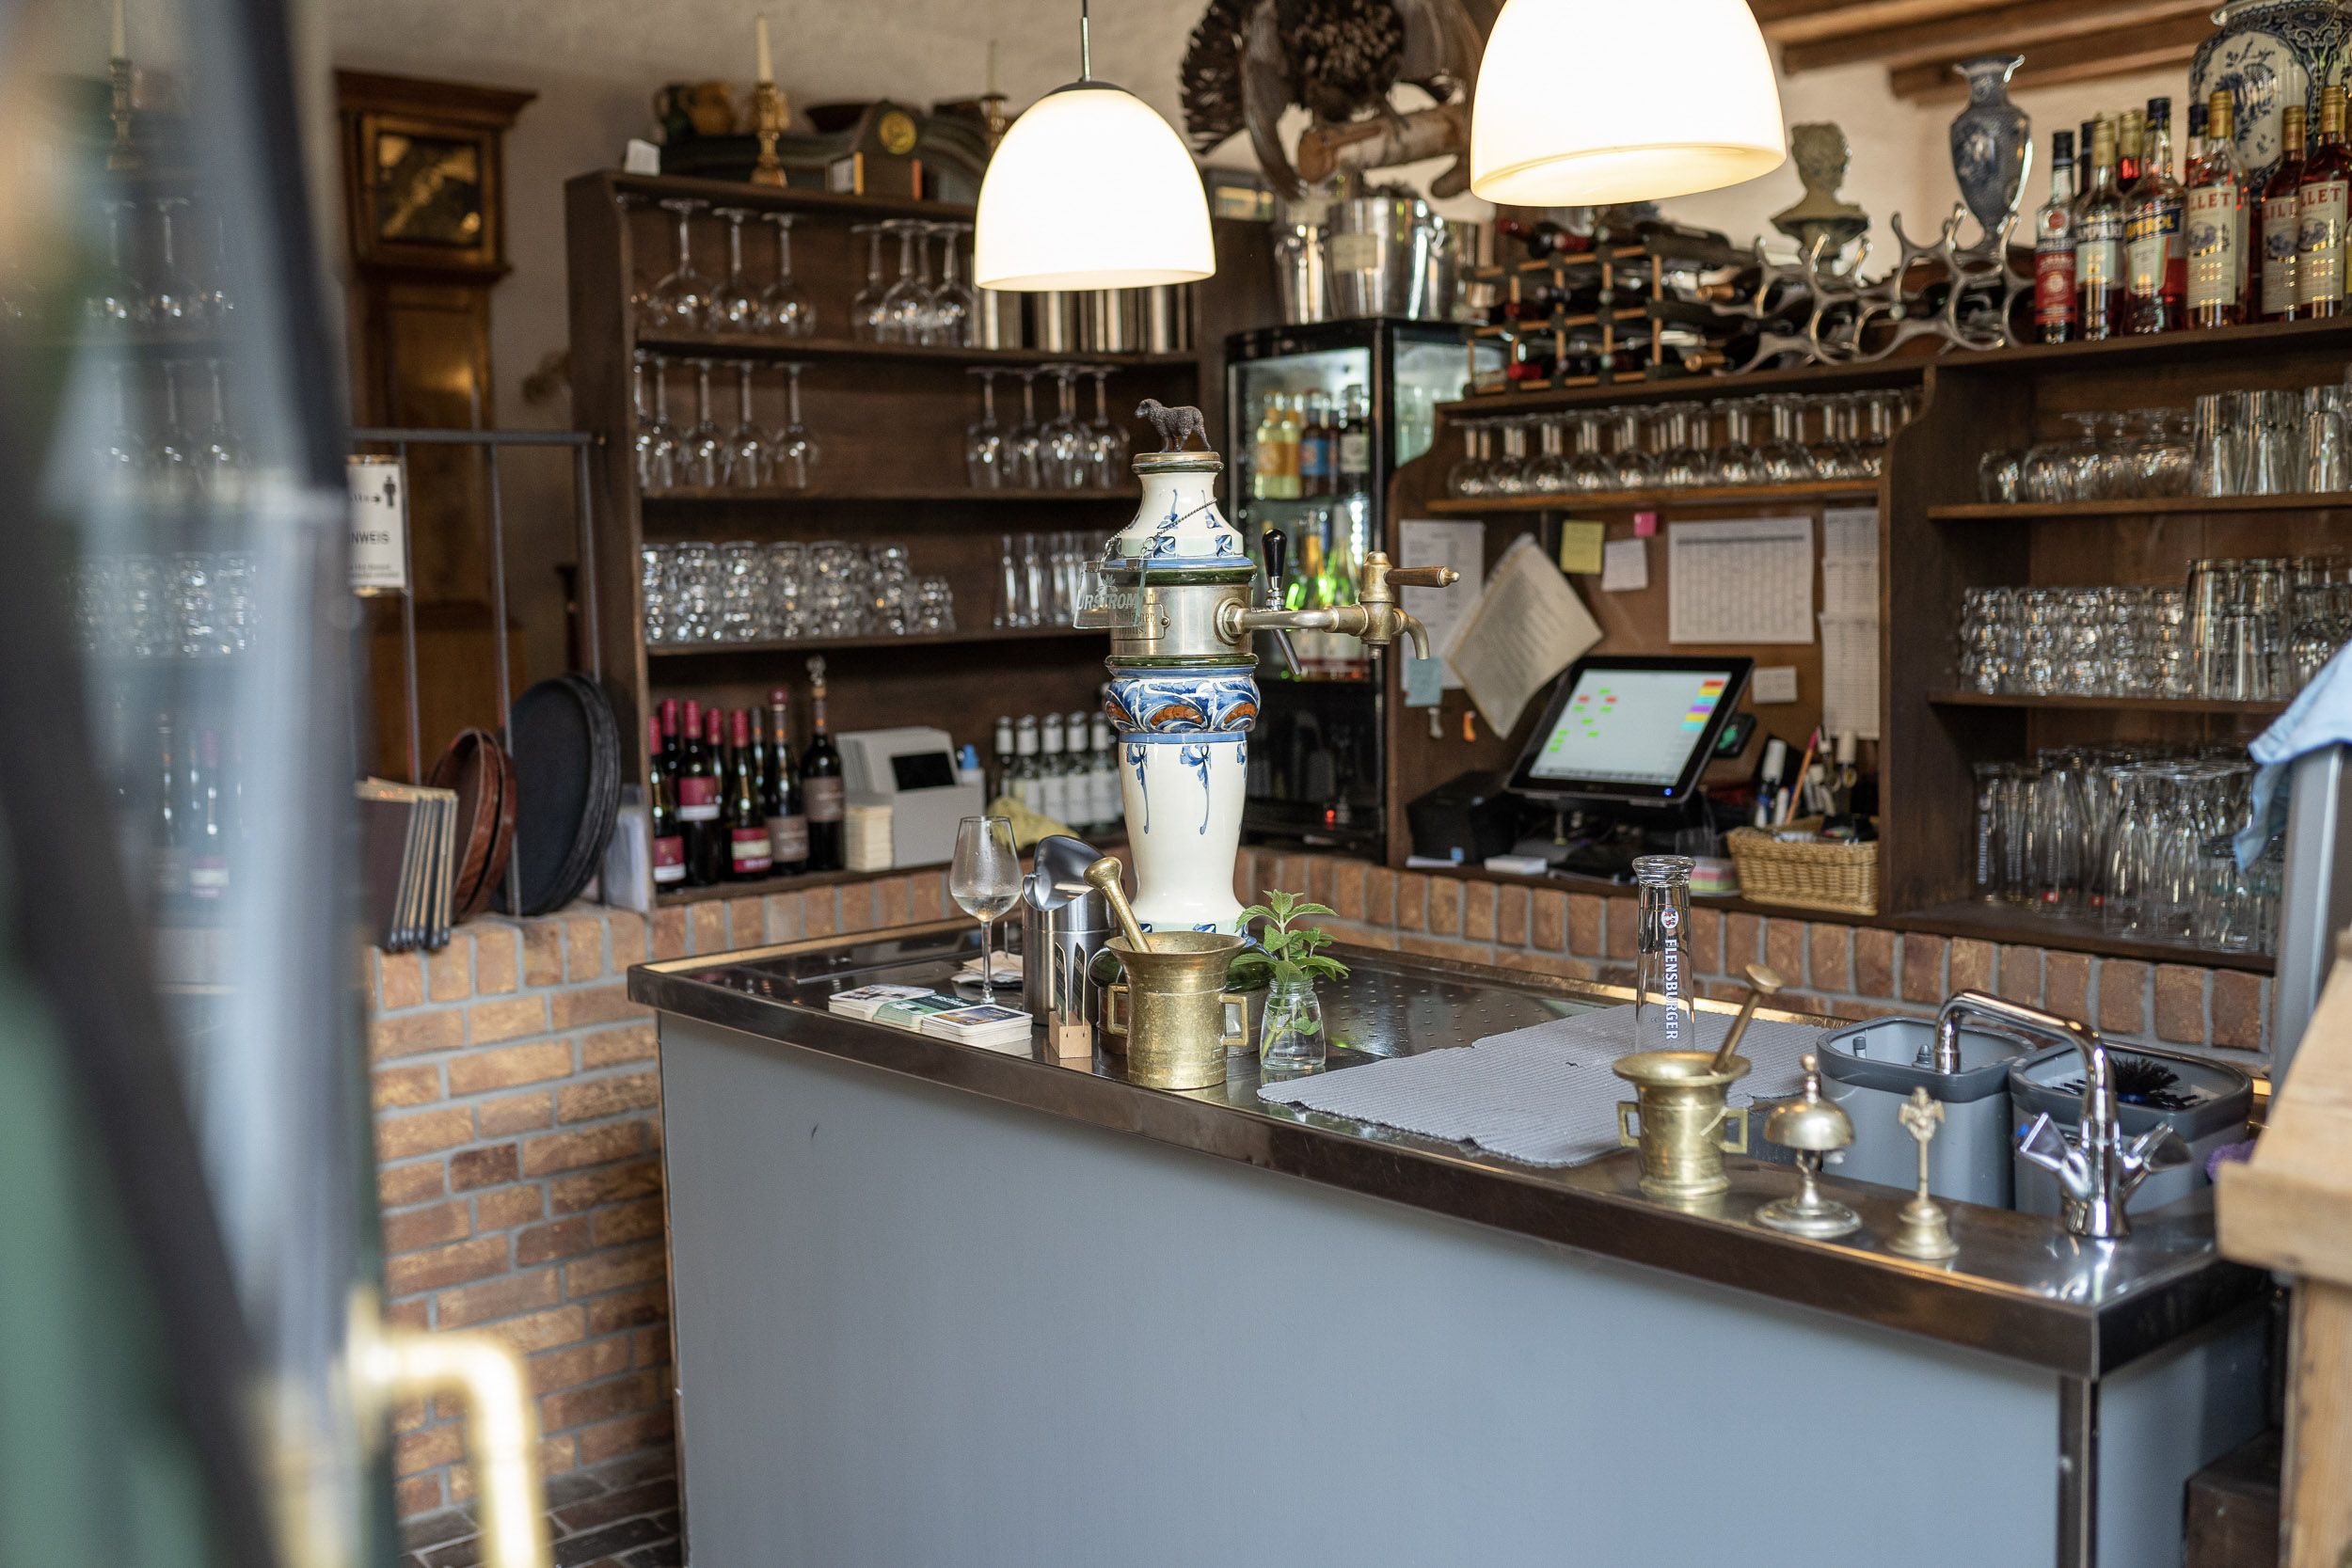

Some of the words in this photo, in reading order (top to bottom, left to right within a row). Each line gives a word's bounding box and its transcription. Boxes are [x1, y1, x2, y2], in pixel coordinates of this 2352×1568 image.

[2187, 192, 2231, 212] LLET
[2300, 187, 2342, 208] LLET
[2076, 222, 2122, 243] AMPARI
[350, 531, 389, 545] NWEIS
[1664, 938, 1678, 1040] FLENSBURGER
